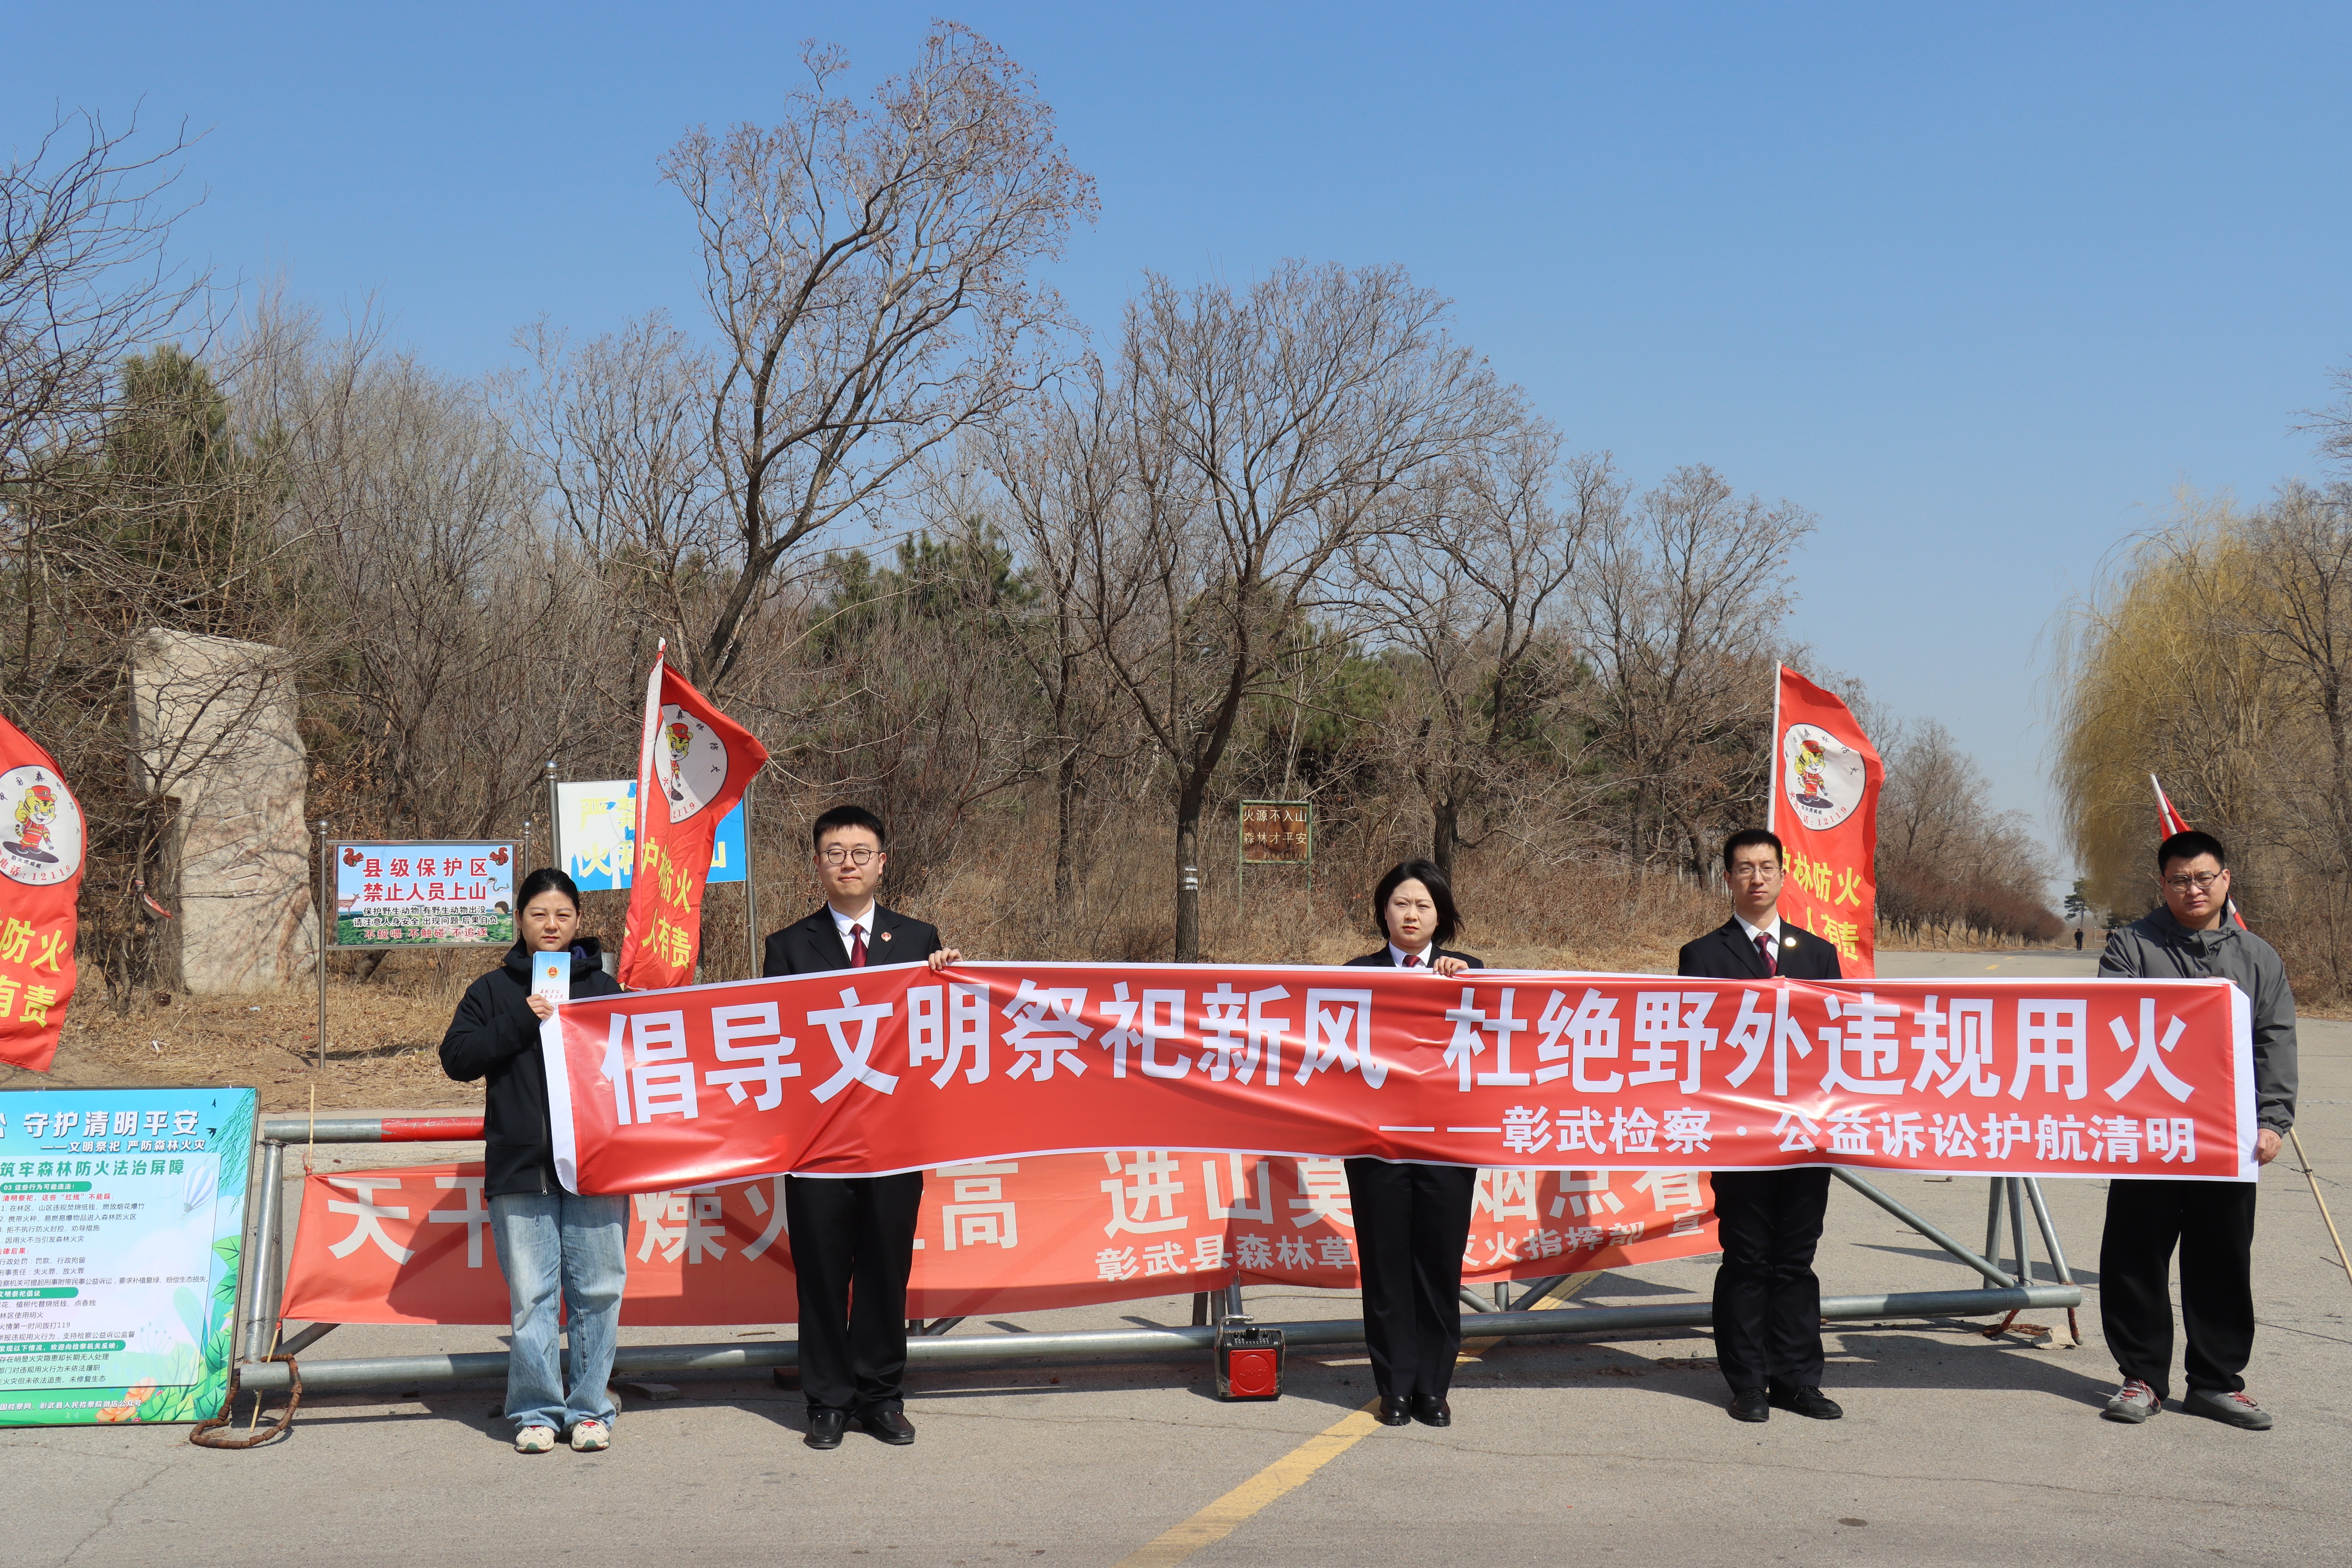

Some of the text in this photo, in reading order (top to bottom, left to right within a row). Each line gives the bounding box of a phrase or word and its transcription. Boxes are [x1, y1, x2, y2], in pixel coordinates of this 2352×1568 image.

[1243, 809, 1307, 822] 火源不入山
[1243, 832, 1307, 844] 森林才平安
[362, 857, 488, 878] 县级保护区
[362, 881, 487, 902] 禁止人员上山
[363, 906, 486, 916] 保护野生动物 有野生动物出没
[354, 916, 498, 927] 请注意人身安全 出现问题 后果自负
[364, 927, 488, 940] 不投喂 不触碰 不追逐
[600, 978, 2195, 1125] 倡导文明祭祀新风 杜绝野外违规用火
[24, 1110, 198, 1138] 守护清明平安
[127, 1139, 205, 1152] 严防森林火灾
[0, 1159, 185, 1178] 筑牢森林防火法治屏障
[0, 1299, 96, 1308] 花、植树代替烧纸钱、点香烛
[0, 1375, 106, 1385] 火灾但未依法追责、未修复生态
